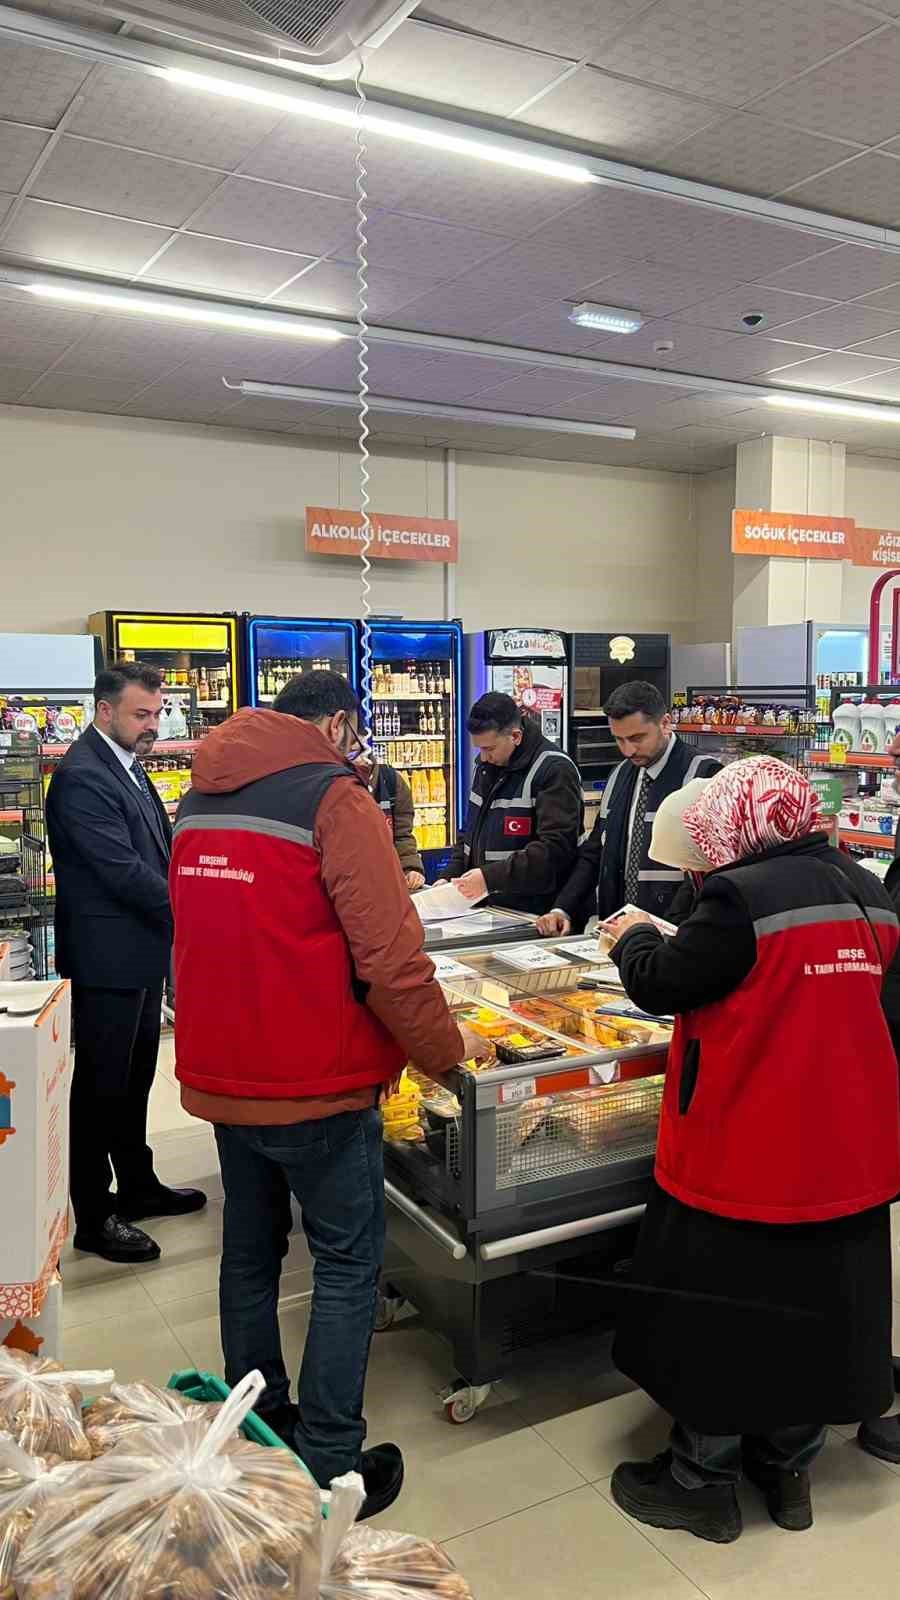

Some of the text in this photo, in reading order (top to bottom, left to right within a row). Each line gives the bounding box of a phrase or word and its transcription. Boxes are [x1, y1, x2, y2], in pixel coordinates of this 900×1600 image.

[377, 526, 451, 548] İÇECEKLER
[744, 524, 846, 545] SOĞUK İÇECEKLER
[878, 532, 900, 547] AĞIZ
